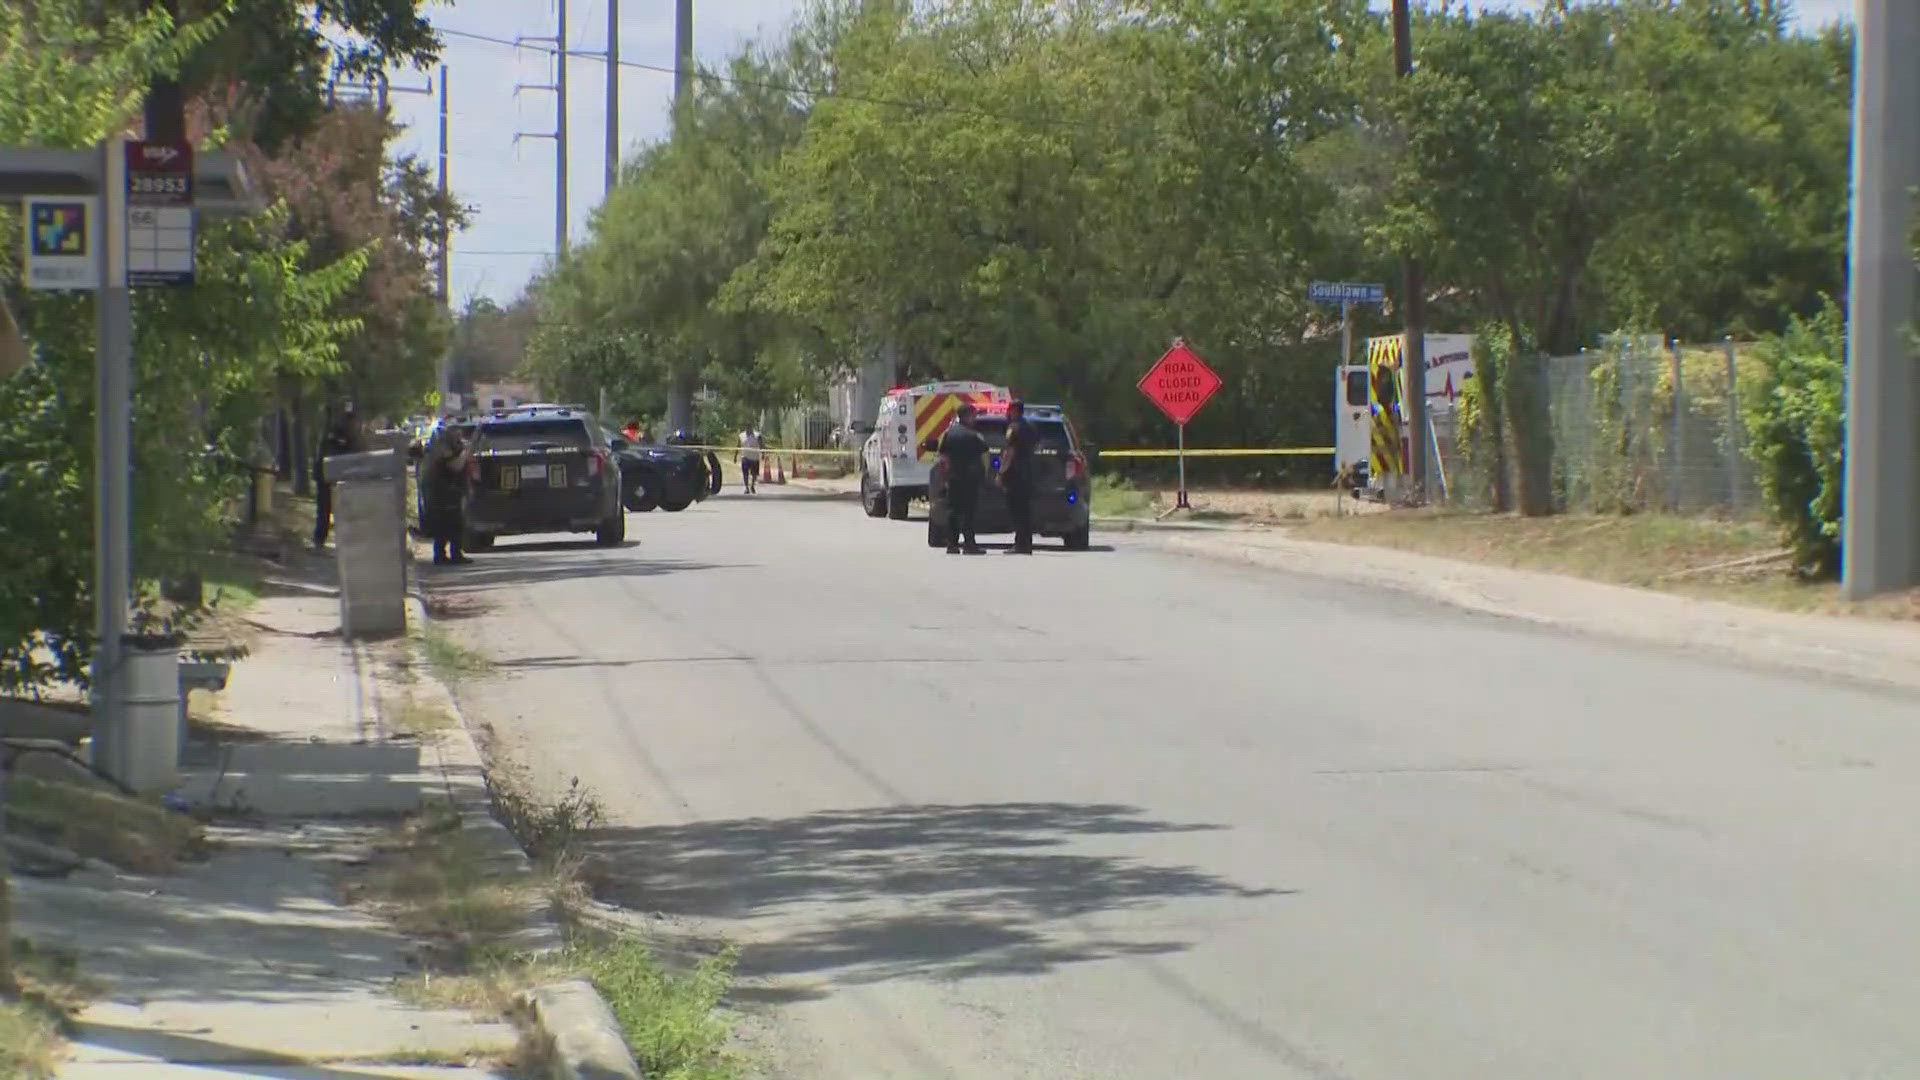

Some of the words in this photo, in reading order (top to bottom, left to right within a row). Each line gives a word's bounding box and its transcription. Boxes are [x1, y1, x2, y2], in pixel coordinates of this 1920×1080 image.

[131, 177, 186, 192] 28953
[1312, 283, 1367, 298] Southlawn
[1165, 363, 1195, 374] ROAD
[1159, 376, 1201, 389] CLOSED
[1163, 391, 1200, 403] AHEAD
